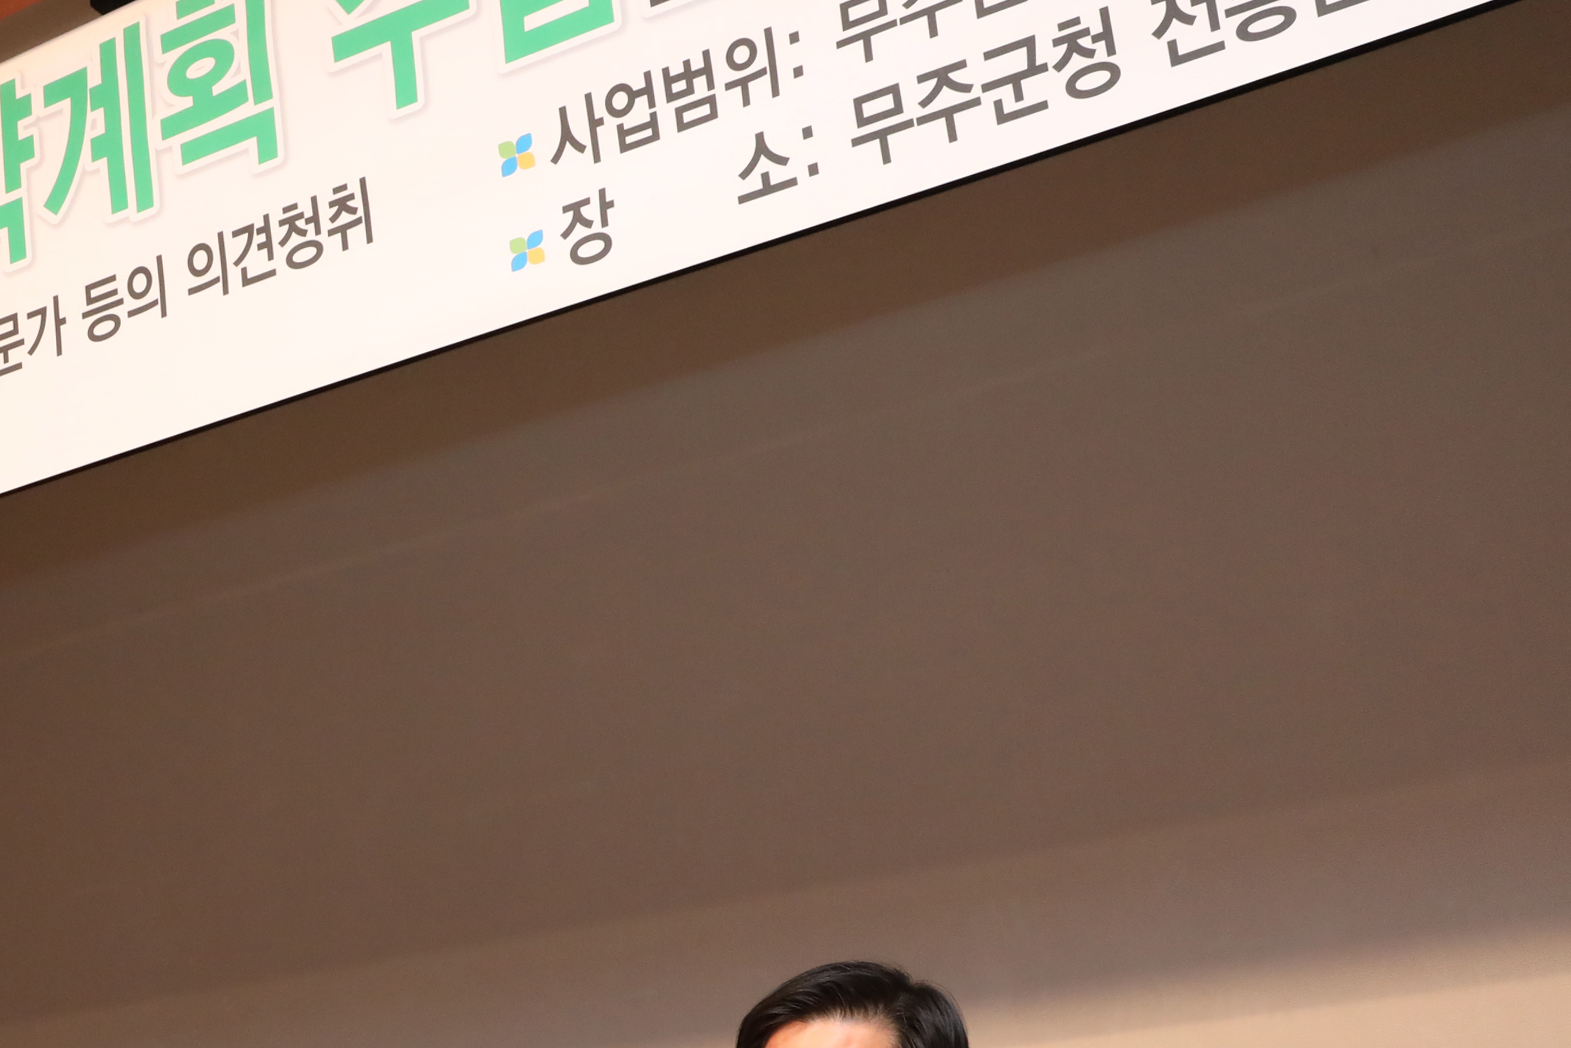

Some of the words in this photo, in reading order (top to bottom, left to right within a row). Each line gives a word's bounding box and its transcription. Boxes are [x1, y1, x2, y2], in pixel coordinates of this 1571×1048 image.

[550, 26, 804, 165] 사업범위:
[560, 188, 615, 266] 장
[850, 6, 1121, 164] 무주군청
[81, 255, 167, 342] 등의
[187, 177, 374, 296] 의견청취
